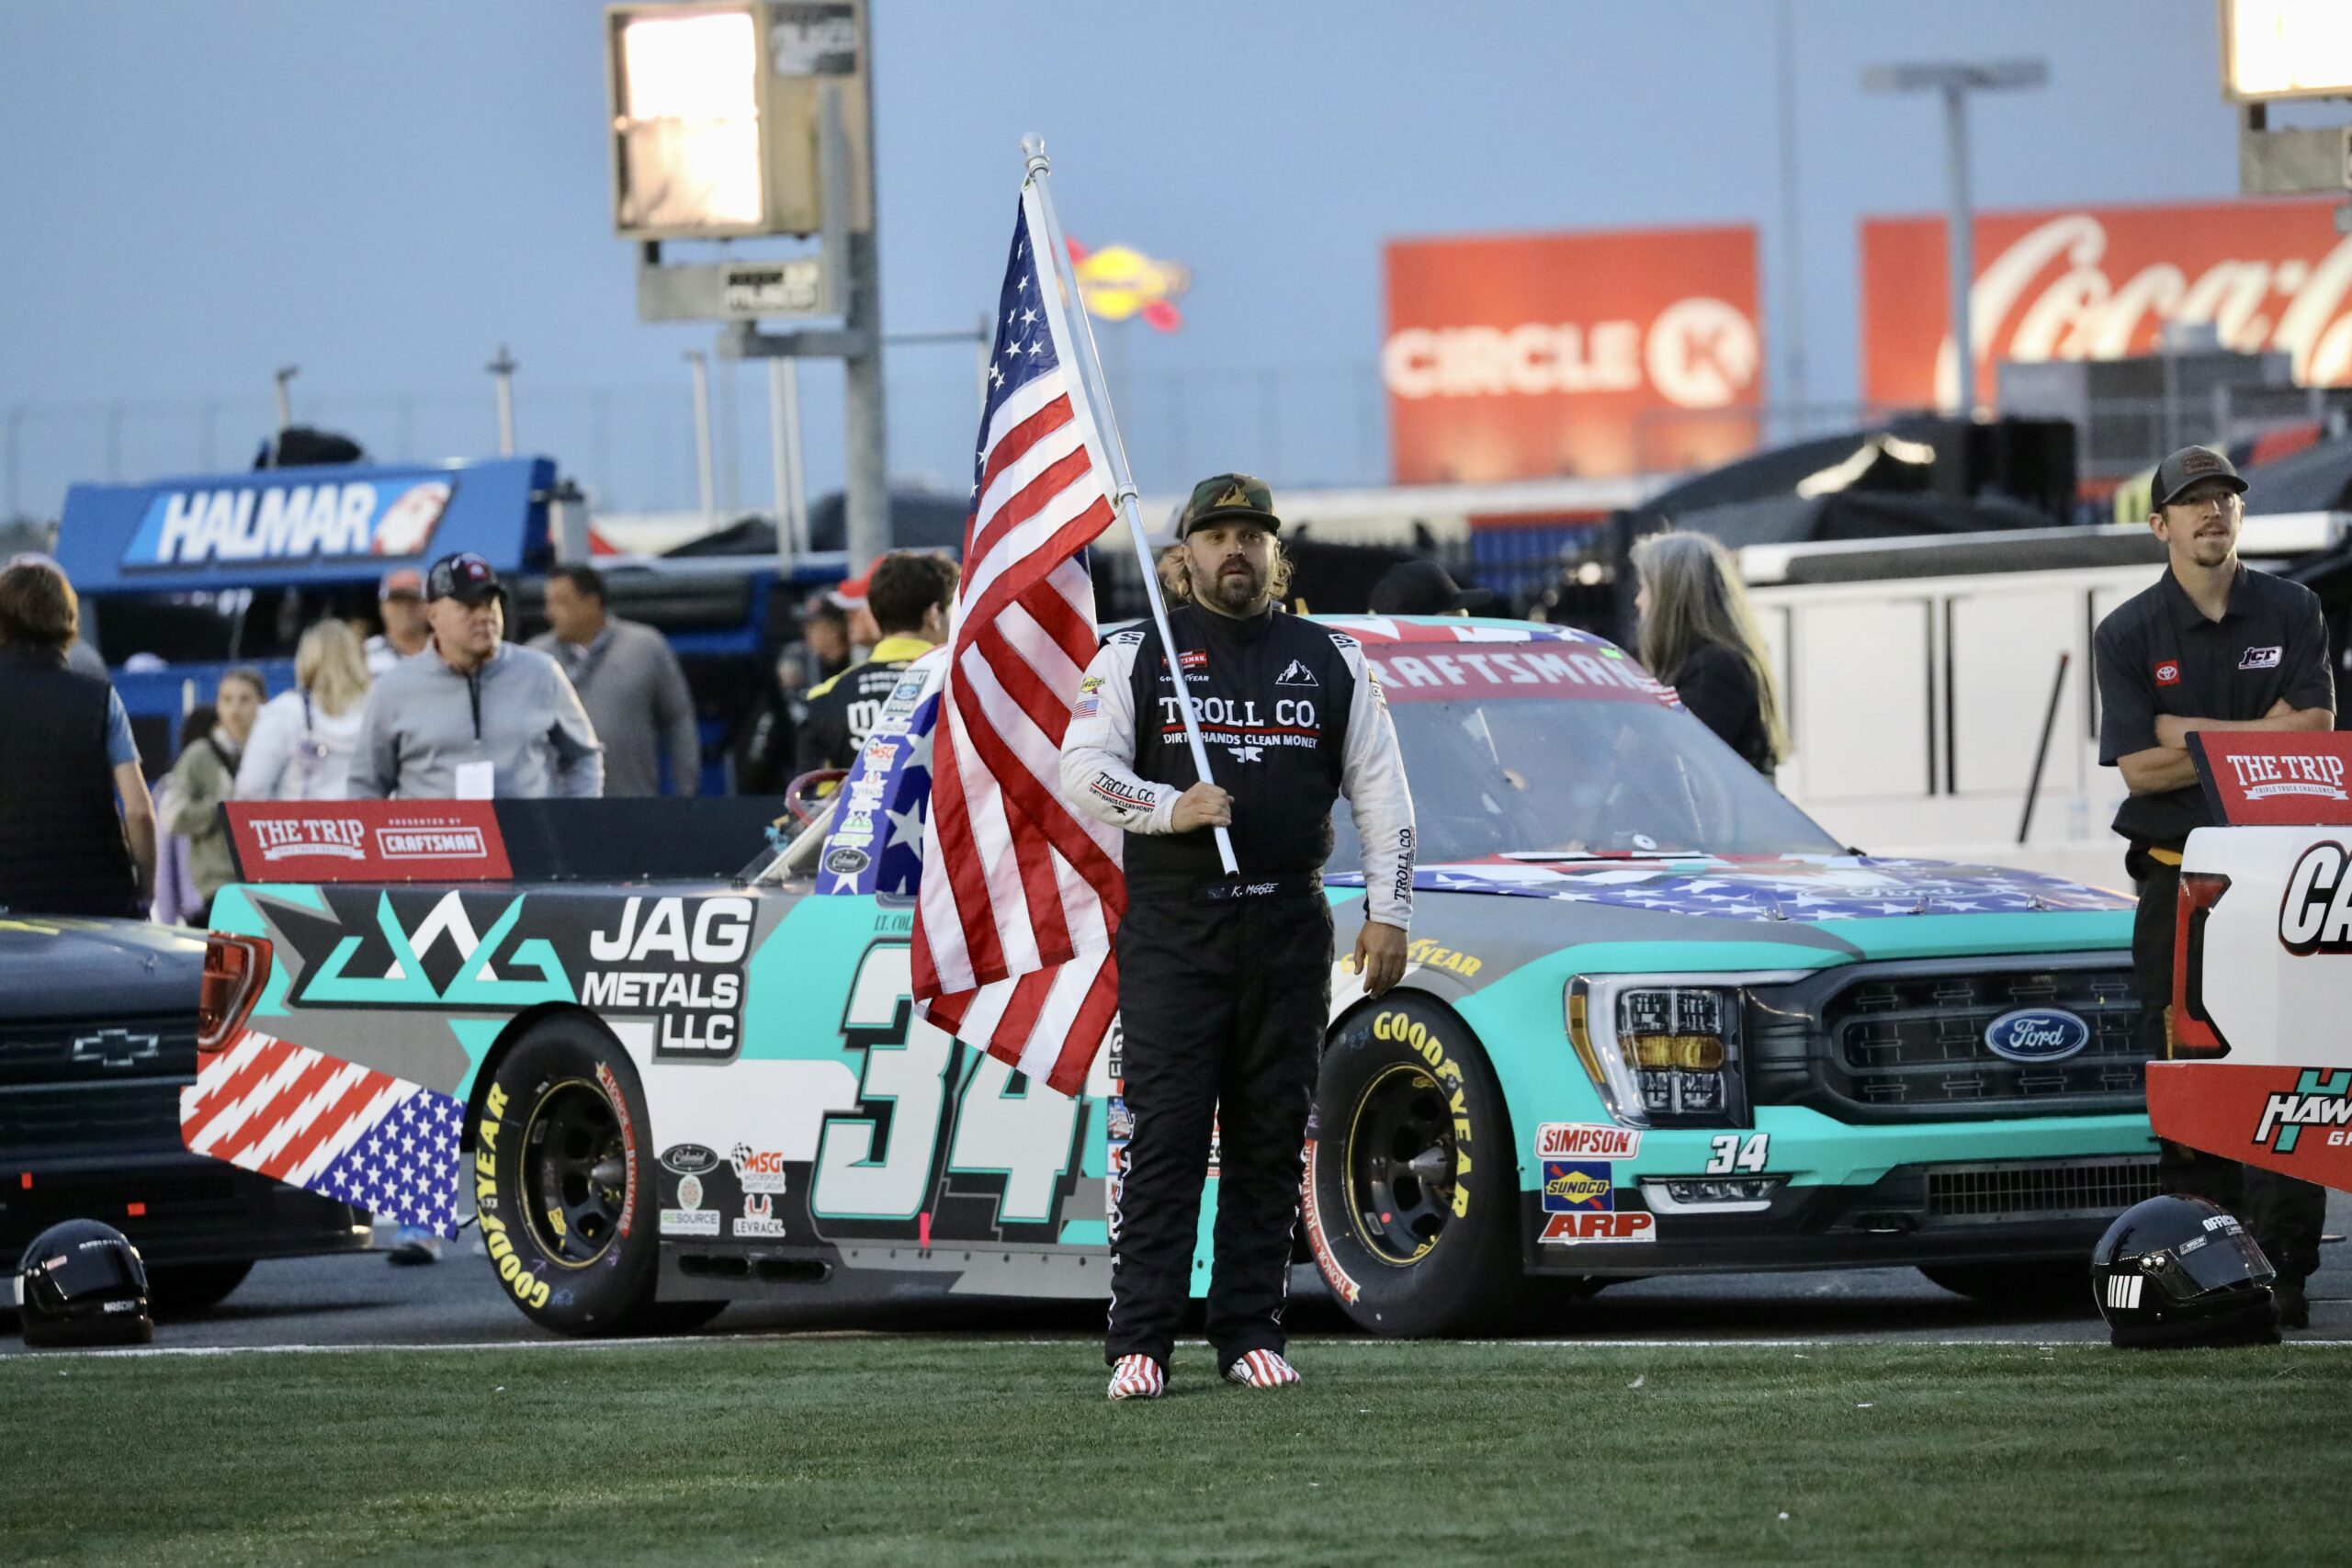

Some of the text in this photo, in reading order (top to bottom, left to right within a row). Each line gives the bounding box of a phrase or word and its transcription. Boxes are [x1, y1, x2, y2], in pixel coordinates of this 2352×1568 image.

[1382, 321, 1642, 399] CIRCLE
[157, 481, 378, 562] HALMAR
[1159, 674, 1209, 682] GOYEAR
[1366, 653, 1642, 690] RAFTSMAN
[1159, 696, 1320, 729] TROLL CO.
[1163, 732, 1317, 749] DIRT HANDS CLEAN MONEY
[2226, 755, 2344, 785] THE TRIP
[1096, 772, 1155, 804] TROLL CO.
[2255, 785, 2276, 795] TRIPLE
[2299, 784, 2335, 795] CHALLENGE
[1118, 799, 1137, 810] CLEAN
[249, 819, 365, 849] THE TRIP
[386, 833, 479, 852] CRAFTSMAN
[1230, 885, 1243, 897] K.
[1394, 852, 1410, 901] TROLL
[590, 897, 752, 963] JAG
[582, 972, 739, 1009] METALS
[662, 1014, 734, 1049] LLC
[2009, 1019, 2064, 1047] Ford
[814, 946, 1081, 1224] 34
[1544, 1130, 1633, 1153] SIMPSON
[1706, 1134, 1770, 1175] 34
[744, 1151, 783, 1173] MSG
[1548, 1180, 1609, 1194] SUNOCO
[662, 1212, 718, 1224] RESOURCE
[735, 1222, 781, 1234] LEVRACK
[1543, 1213, 1652, 1236] ARP
[1317, 1250, 1348, 1296] HONOR
